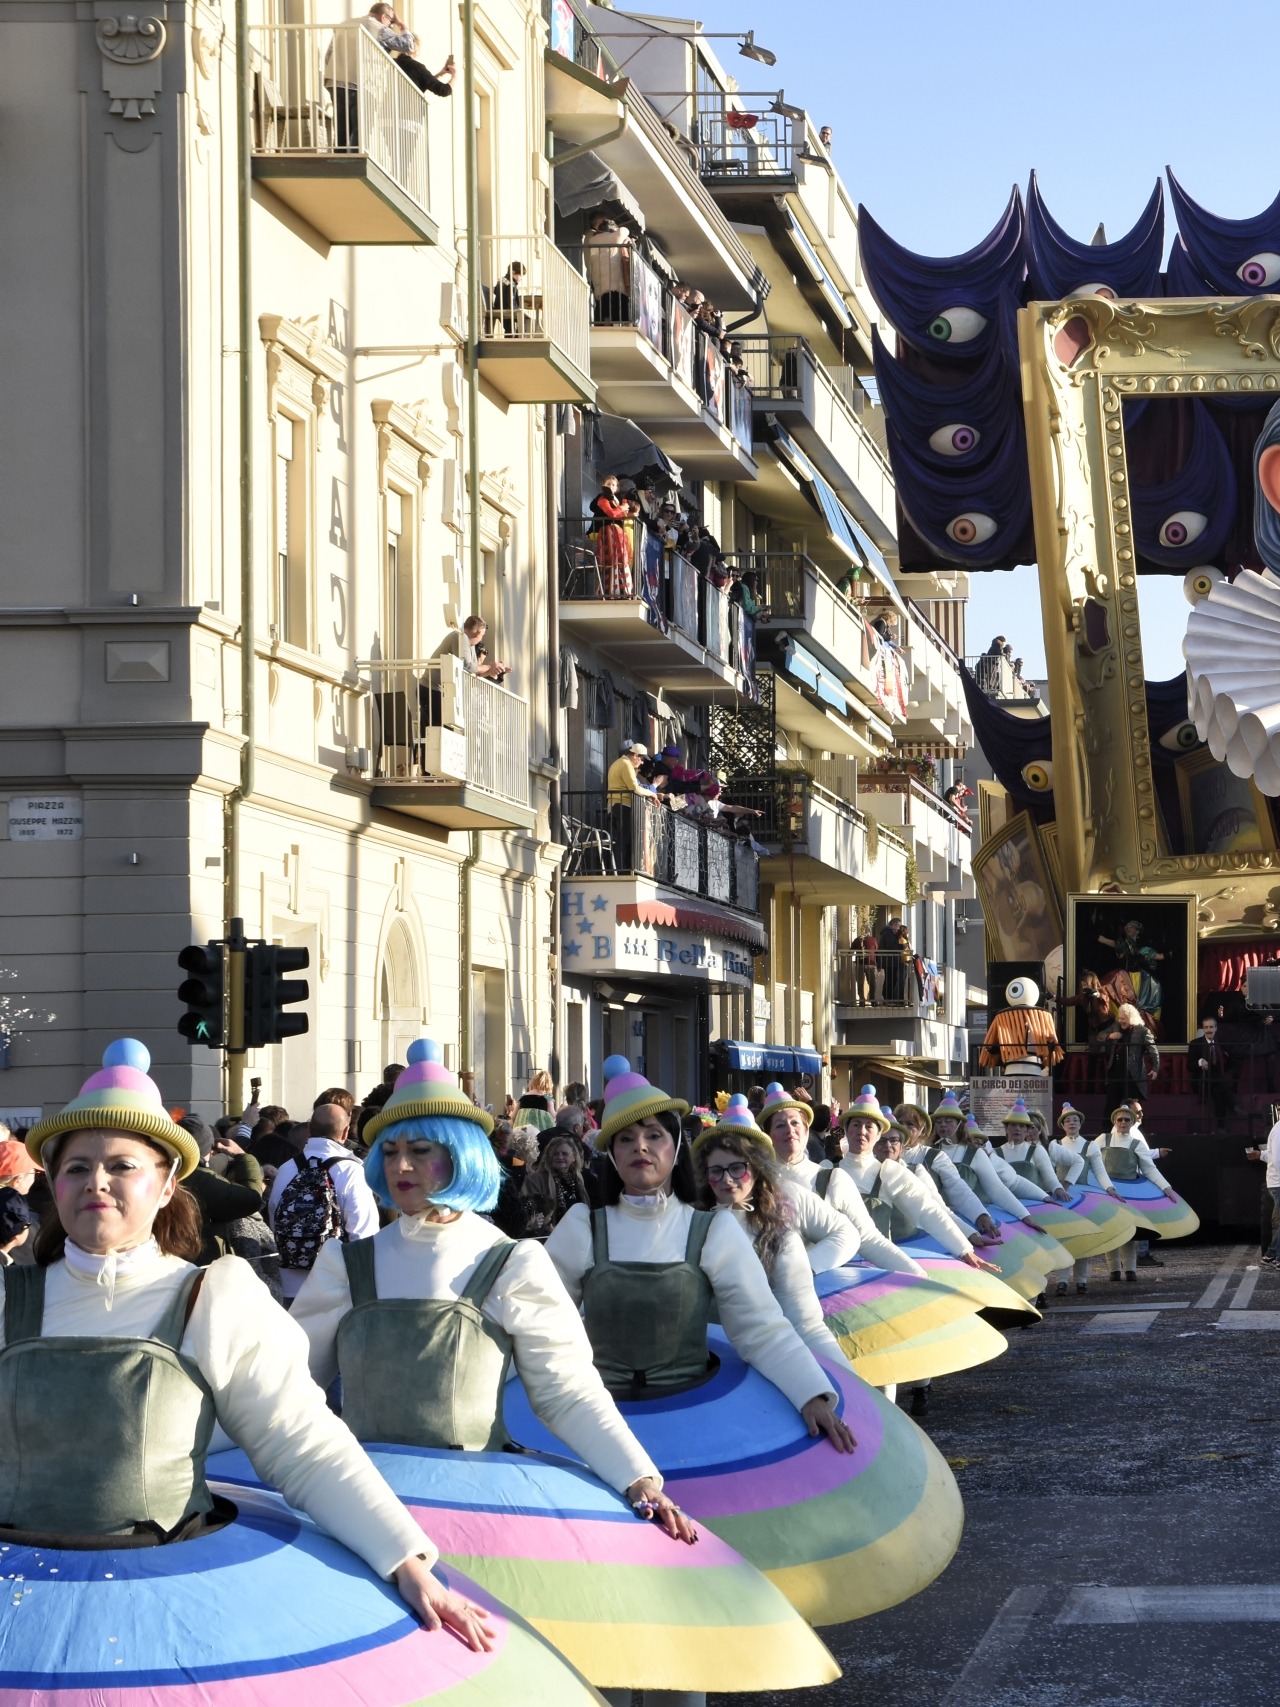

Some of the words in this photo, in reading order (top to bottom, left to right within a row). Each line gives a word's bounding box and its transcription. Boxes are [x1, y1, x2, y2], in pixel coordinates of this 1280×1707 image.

[28, 801, 65, 810] PIAZZA
[9, 817, 47, 826] GIUSEPPE
[562, 892, 584, 917] H
[592, 935, 612, 959] B
[655, 938, 718, 969] Bella
[973, 1080, 980, 1089] IL
[982, 1080, 1007, 1089] CIRCO
[1009, 1080, 1022, 1089] DEI
[1024, 1080, 1049, 1089] SOGNI
